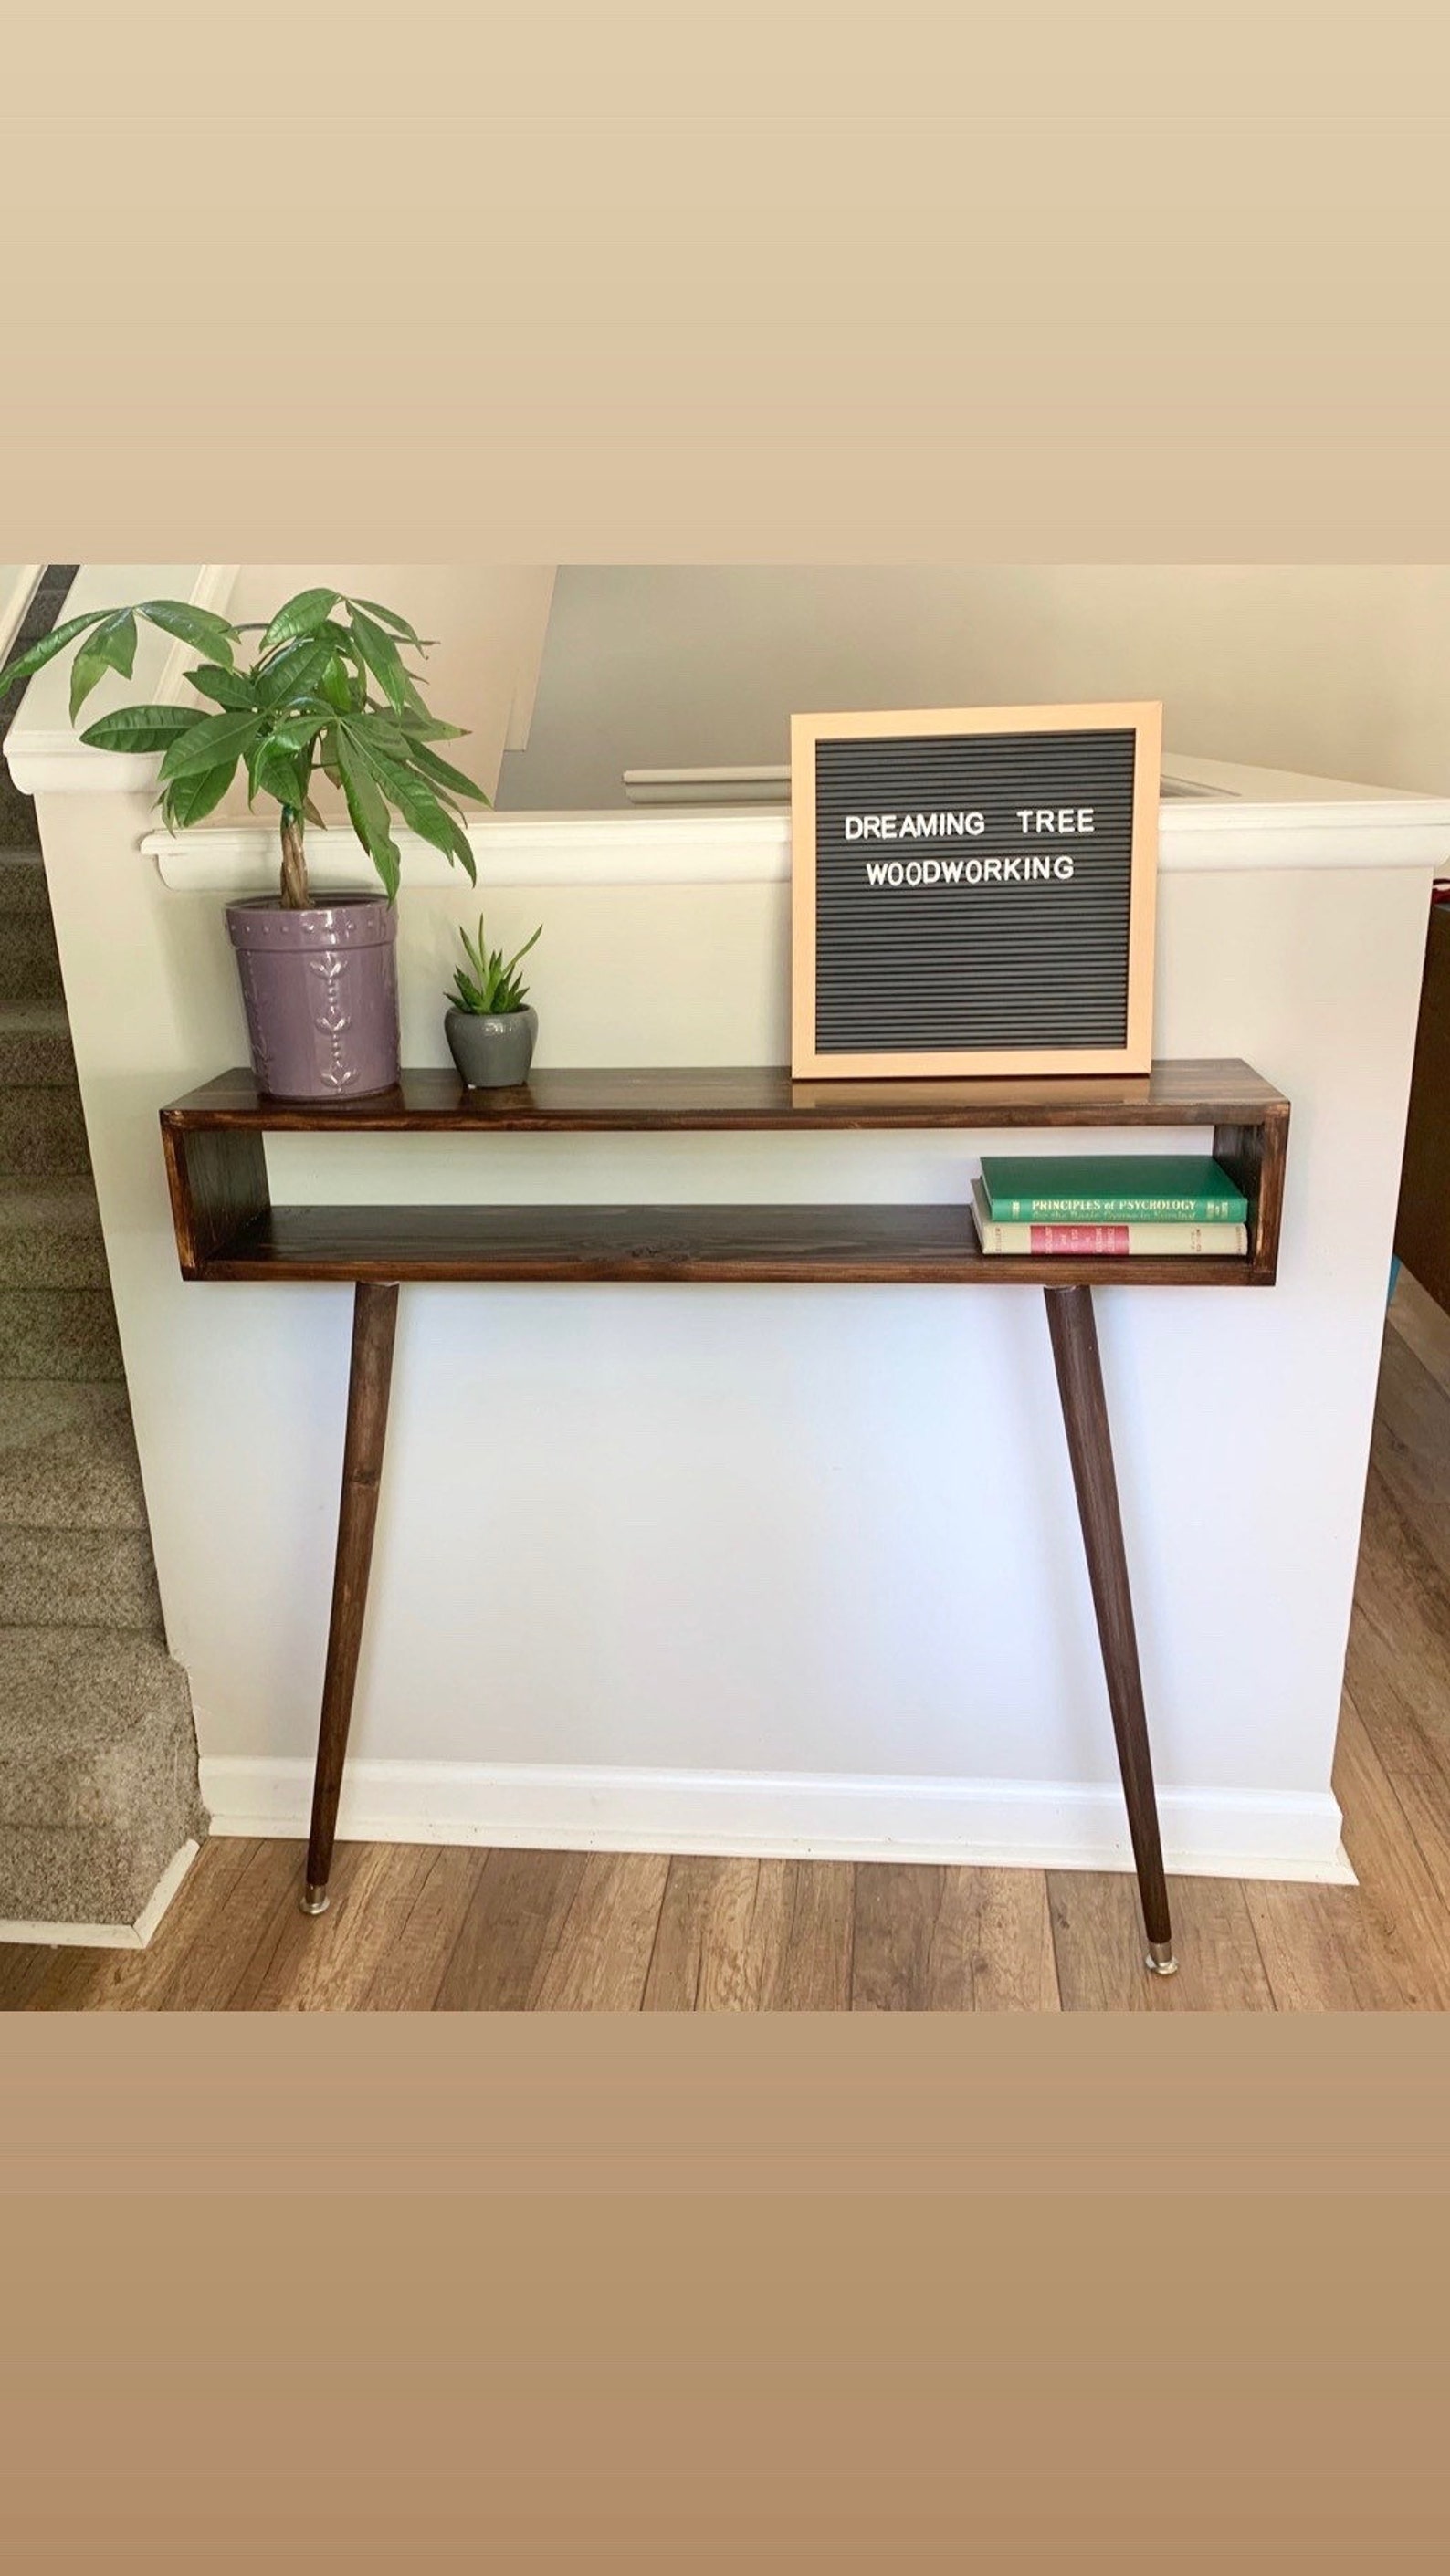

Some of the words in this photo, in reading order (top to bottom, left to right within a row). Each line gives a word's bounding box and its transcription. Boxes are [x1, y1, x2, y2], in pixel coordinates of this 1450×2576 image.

[845, 812, 985, 840] DREAMING
[1016, 808, 1095, 833] TREE
[866, 855, 1074, 886] WOODWORKING
[1032, 1199, 1101, 1211] PRINCIPLES
[1104, 1201, 1114, 1210] of
[1119, 1199, 1196, 1211] PSYCHOLOGY
